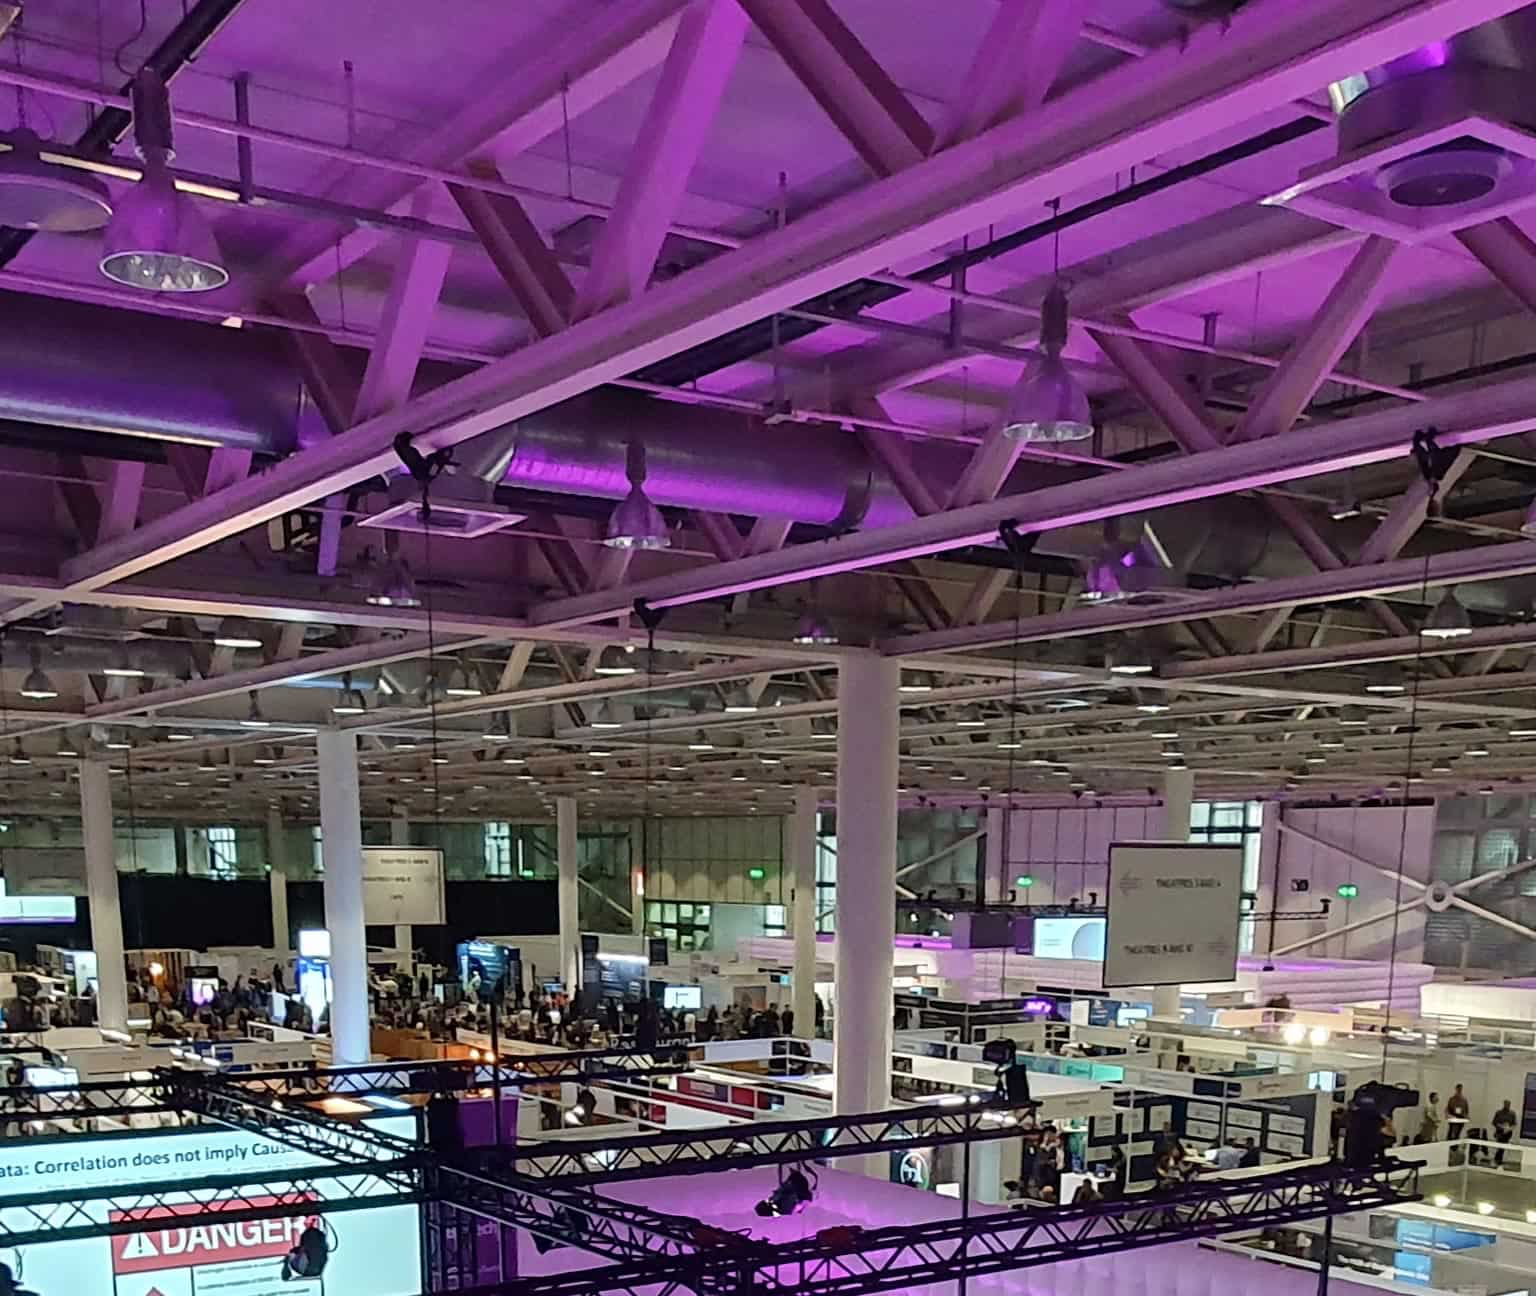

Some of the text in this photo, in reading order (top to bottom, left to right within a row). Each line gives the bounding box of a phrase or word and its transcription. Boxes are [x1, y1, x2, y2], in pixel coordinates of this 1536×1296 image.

[34, 1156, 128, 1175] Correlation
[132, 1151, 170, 1167] does
[175, 1149, 201, 1163] not
[205, 1143, 247, 1161] imply
[252, 1142, 291, 1156] Caus
[160, 1215, 309, 1255] DANGER
